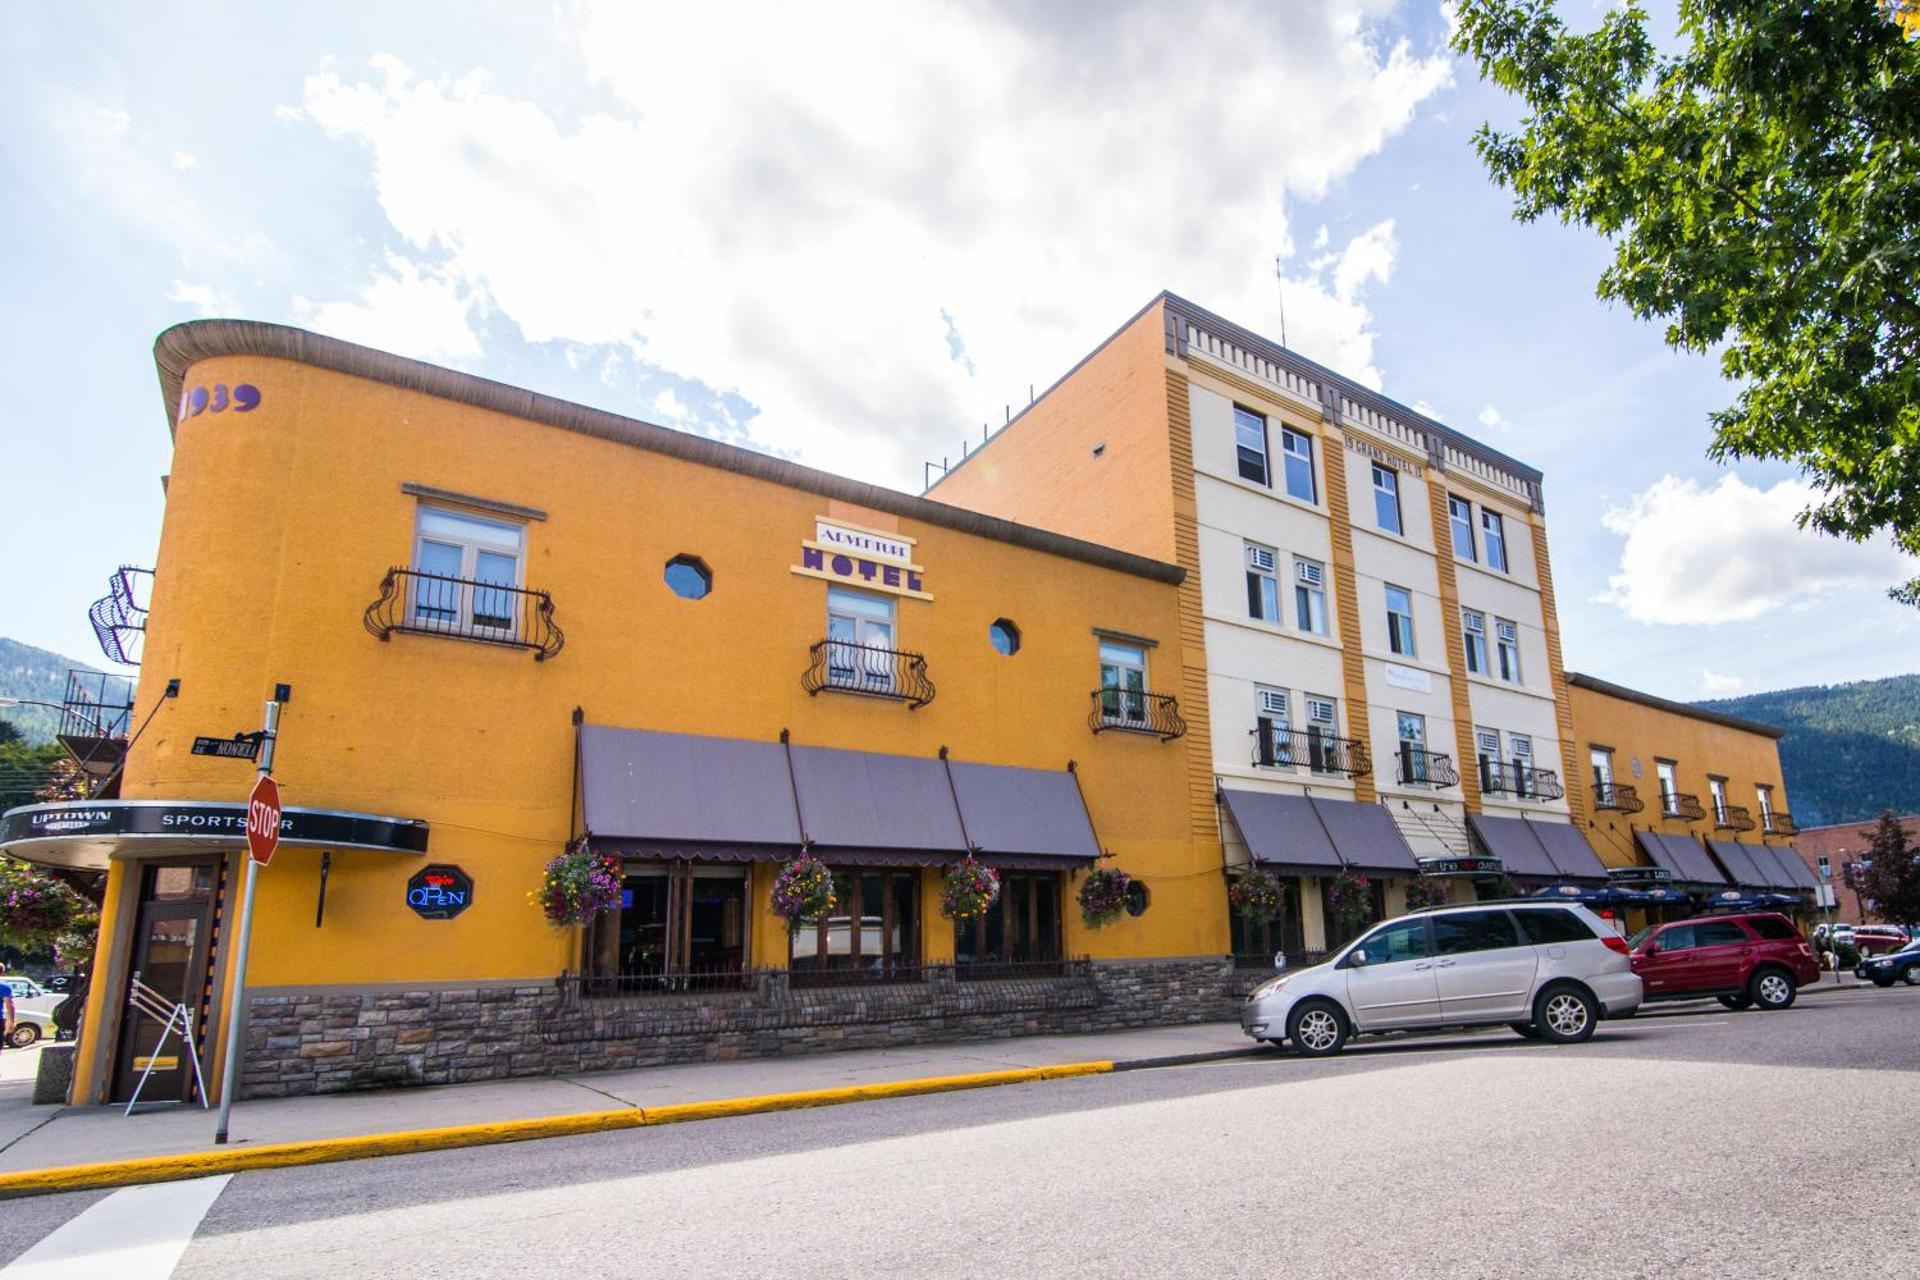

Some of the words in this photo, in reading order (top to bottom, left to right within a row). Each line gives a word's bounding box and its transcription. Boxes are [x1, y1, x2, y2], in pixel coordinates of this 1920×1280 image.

[821, 529, 907, 558] ADVENTURE
[803, 546, 922, 592] HOTEL
[32, 811, 112, 824] UPTOWN
[250, 800, 280, 840] STOP
[409, 886, 465, 906] OPEN
